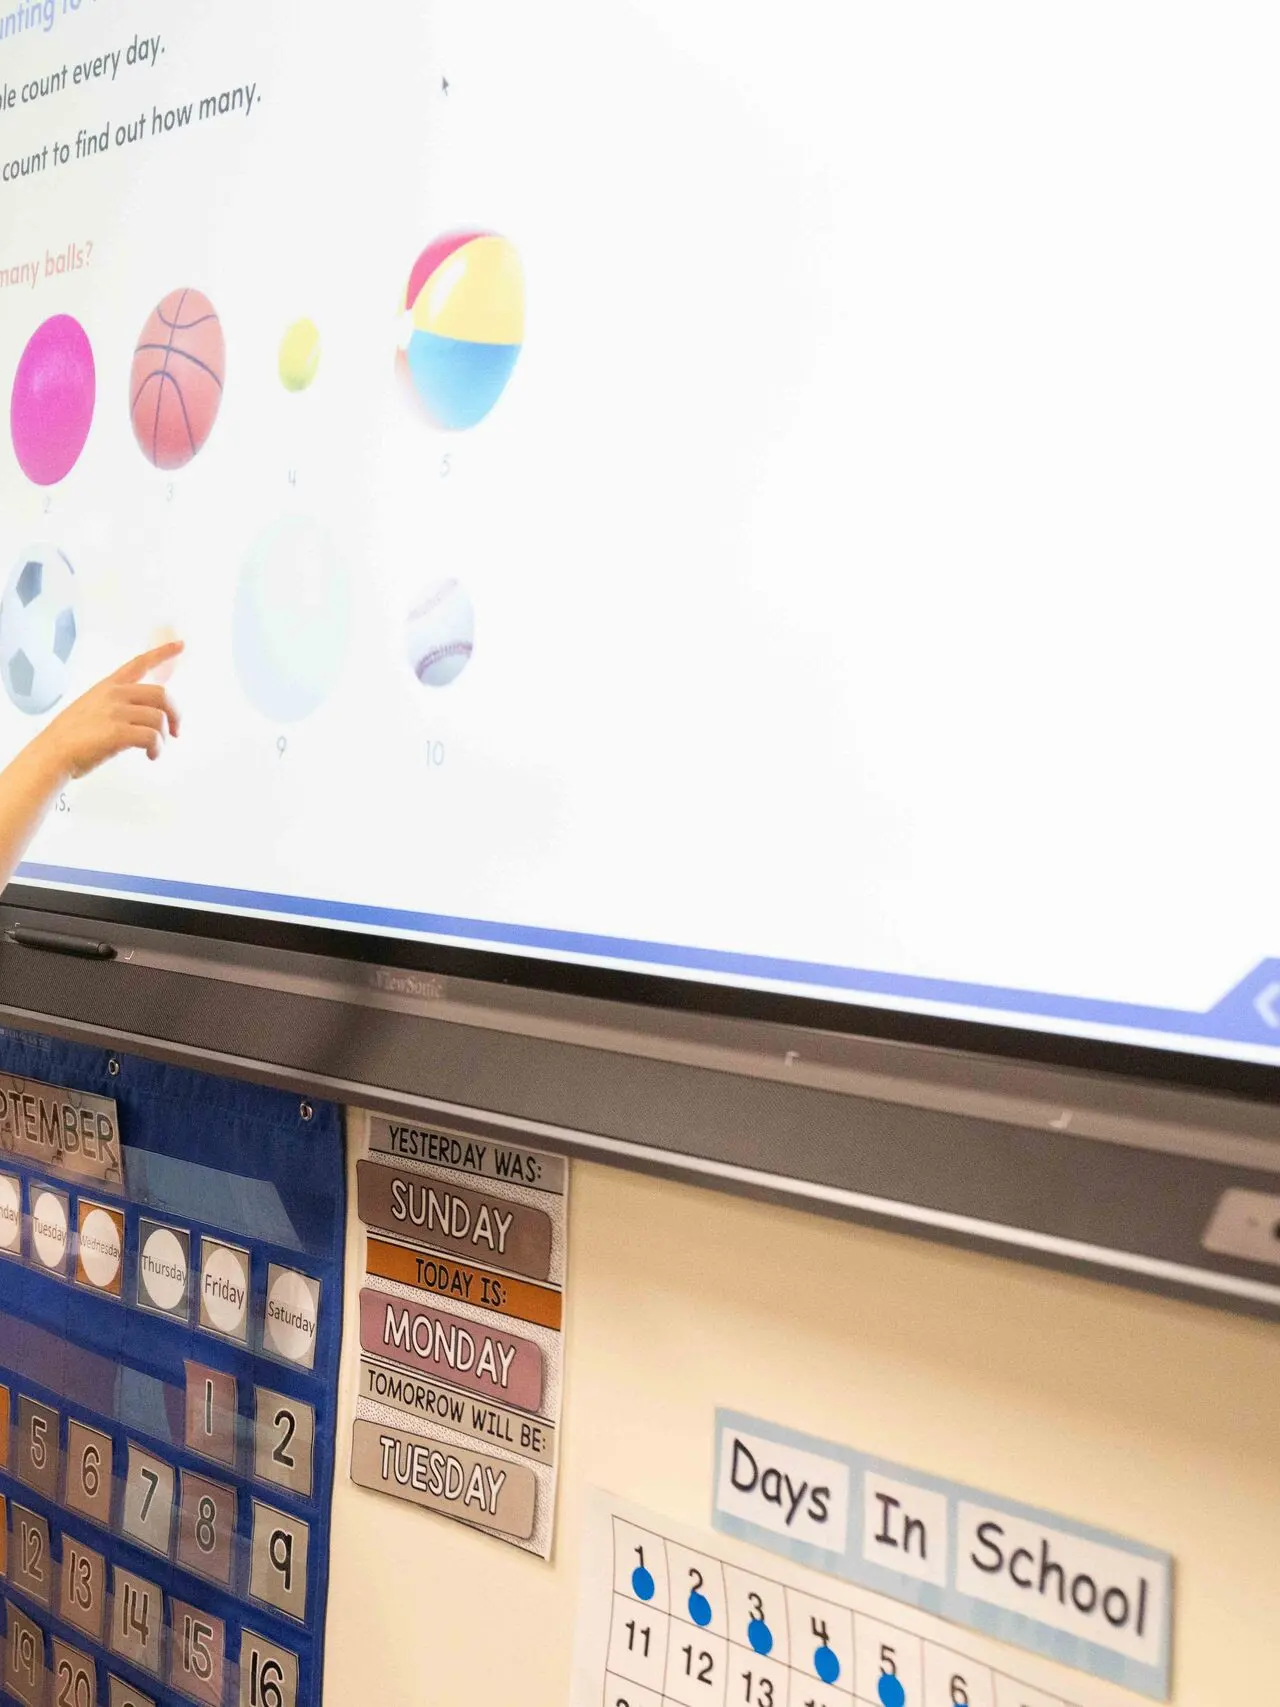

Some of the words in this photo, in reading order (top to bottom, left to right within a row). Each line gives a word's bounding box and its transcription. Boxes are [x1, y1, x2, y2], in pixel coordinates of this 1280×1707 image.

[21, 65, 68, 103] count
[73, 49, 121, 84] every
[126, 34, 165, 67] day.
[2, 145, 48, 182] count
[53, 141, 70, 167] to
[75, 121, 110, 159] find
[115, 113, 146, 147] out
[151, 105, 193, 136] how
[199, 82, 261, 120] many.
[44, 240, 94, 278] balls?
[287, 468, 298, 489] 4
[439, 454, 451, 478] 5
[276, 735, 288, 760] 9
[424, 740, 446, 767] 10
[389, 1125, 486, 1175] YESTERDAY
[494, 1148, 543, 1183] WAS:
[390, 1179, 514, 1255] SUNDAY
[31, 1215, 67, 1246] Tuesday
[79, 1233, 122, 1261] Wednesday
[141, 1254, 188, 1286] Thursday
[204, 1273, 245, 1310] Friday
[267, 1300, 316, 1338] Saturday
[414, 1258, 473, 1296] TODAY
[480, 1277, 507, 1306] IS:
[383, 1304, 517, 1388] MONDAY
[271, 1408, 297, 1470] 2
[368, 1369, 465, 1422] TOMORROW
[471, 1404, 514, 1443] WILL
[520, 1426, 547, 1452] BE:
[30, 1415, 48, 1470] 5
[80, 1443, 101, 1498] 6
[140, 1467, 160, 1523] 7
[194, 1496, 217, 1554] 8
[269, 1528, 294, 1592] 9
[380, 1436, 507, 1516] TUESDAY
[729, 1438, 832, 1527] Days
[874, 1492, 928, 1559] In
[971, 1521, 1148, 1638] School
[21, 1521, 45, 1582] 12
[69, 1549, 94, 1611] 13
[122, 1582, 150, 1647] 14
[183, 1614, 214, 1680] 15
[250, 1648, 285, 1707] 16
[748, 1592, 765, 1621] 3
[810, 1615, 830, 1647] 4
[880, 1644, 897, 1675] 5
[949, 1673, 969, 1705] 6
[12, 1619, 35, 1687] 19
[58, 1658, 91, 1707] 20
[625, 1620, 651, 1657] 11
[682, 1644, 714, 1686] 12
[741, 1671, 775, 1707] 13
